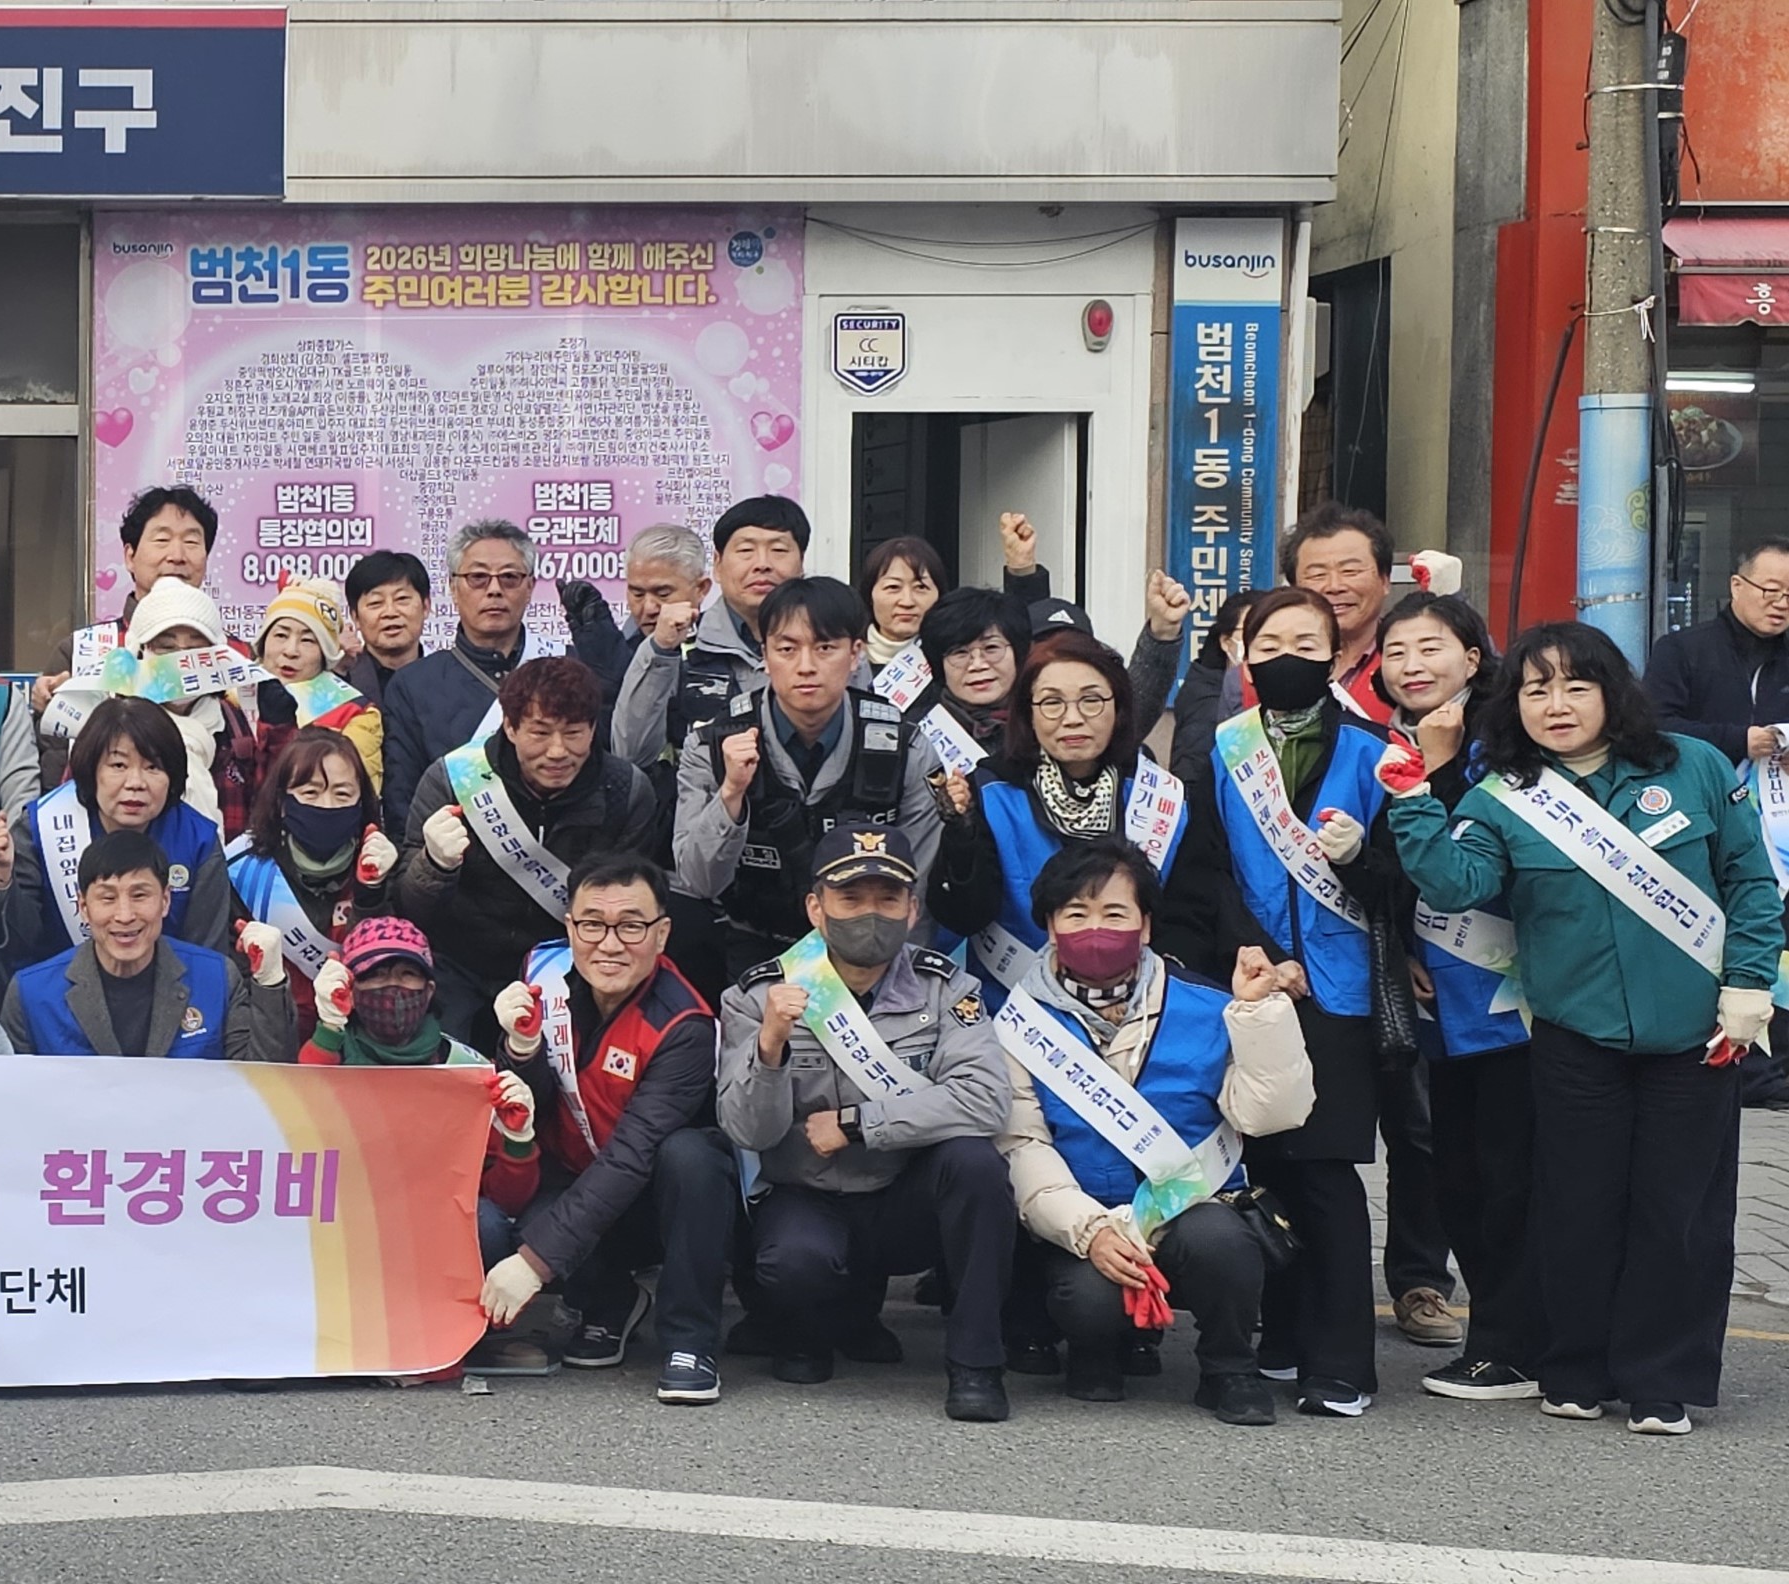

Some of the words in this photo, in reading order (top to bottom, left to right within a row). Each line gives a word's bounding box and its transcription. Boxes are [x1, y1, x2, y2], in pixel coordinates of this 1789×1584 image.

[113, 242, 174, 259] busanjin
[367, 243, 451, 273] 2026년
[459, 243, 578, 272] 희망나눔에
[587, 242, 635, 271] 함께
[643, 242, 714, 271] 해주신
[1185, 250, 1275, 272] busanjin
[191, 245, 350, 304] 범천1동
[364, 273, 531, 308] 주민여러분
[542, 275, 717, 307] 감사합니다.
[842, 319, 899, 330] SECURITY
[849, 356, 888, 367] 시티캅
[1243, 323, 1259, 406] Beomcheon
[276, 484, 355, 514] 범천1동
[533, 481, 613, 512] 범천1동
[1239, 468, 1255, 545] Community
[258, 517, 374, 549] 통장협의회
[527, 516, 619, 546] 유관단체
[1239, 548, 1254, 595] Servic
[38, 1147, 341, 1227] 환경정비
